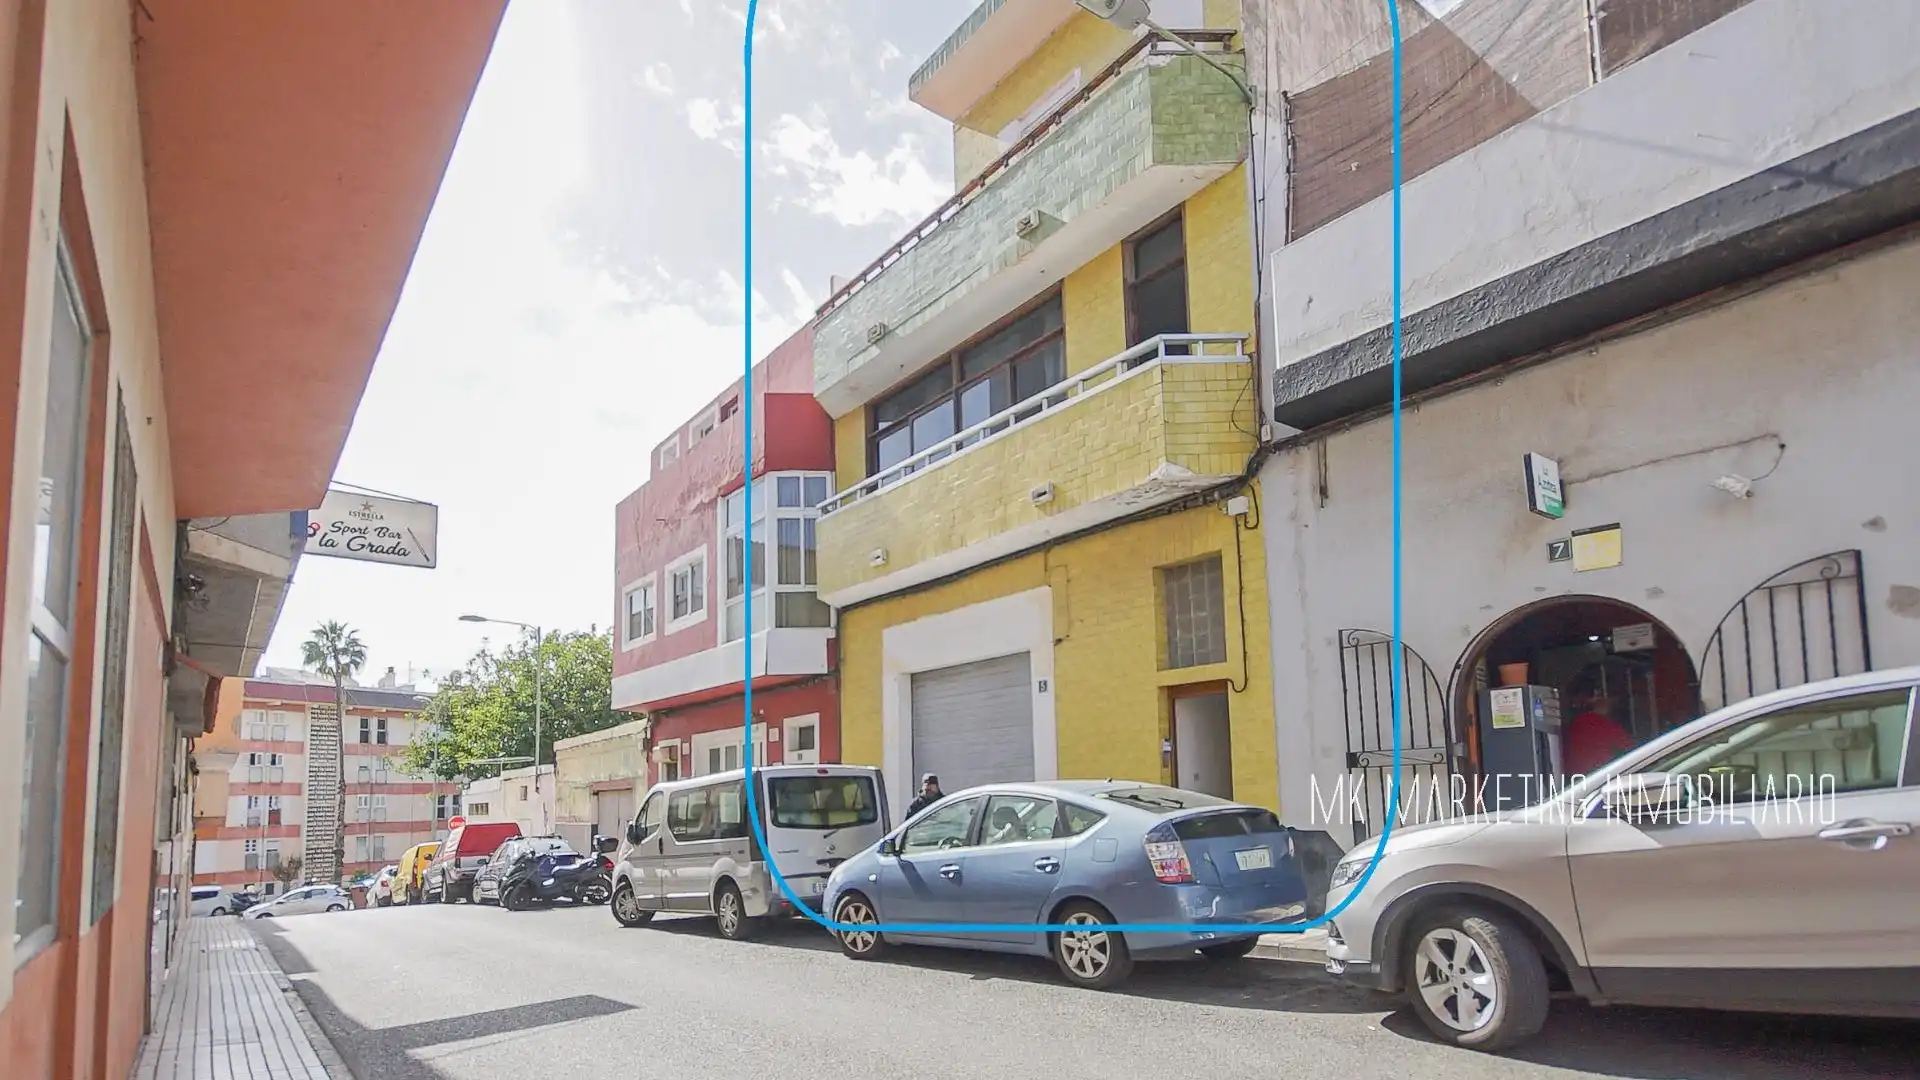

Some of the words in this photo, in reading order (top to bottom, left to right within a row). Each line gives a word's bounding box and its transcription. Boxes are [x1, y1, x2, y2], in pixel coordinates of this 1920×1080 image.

[348, 510, 384, 520] ESTRELLA
[329, 521, 369, 536] Sport
[374, 526, 402, 540] Bar
[318, 533, 340, 548] la
[346, 535, 411, 557] Grada
[1552, 542, 1565, 558] 7
